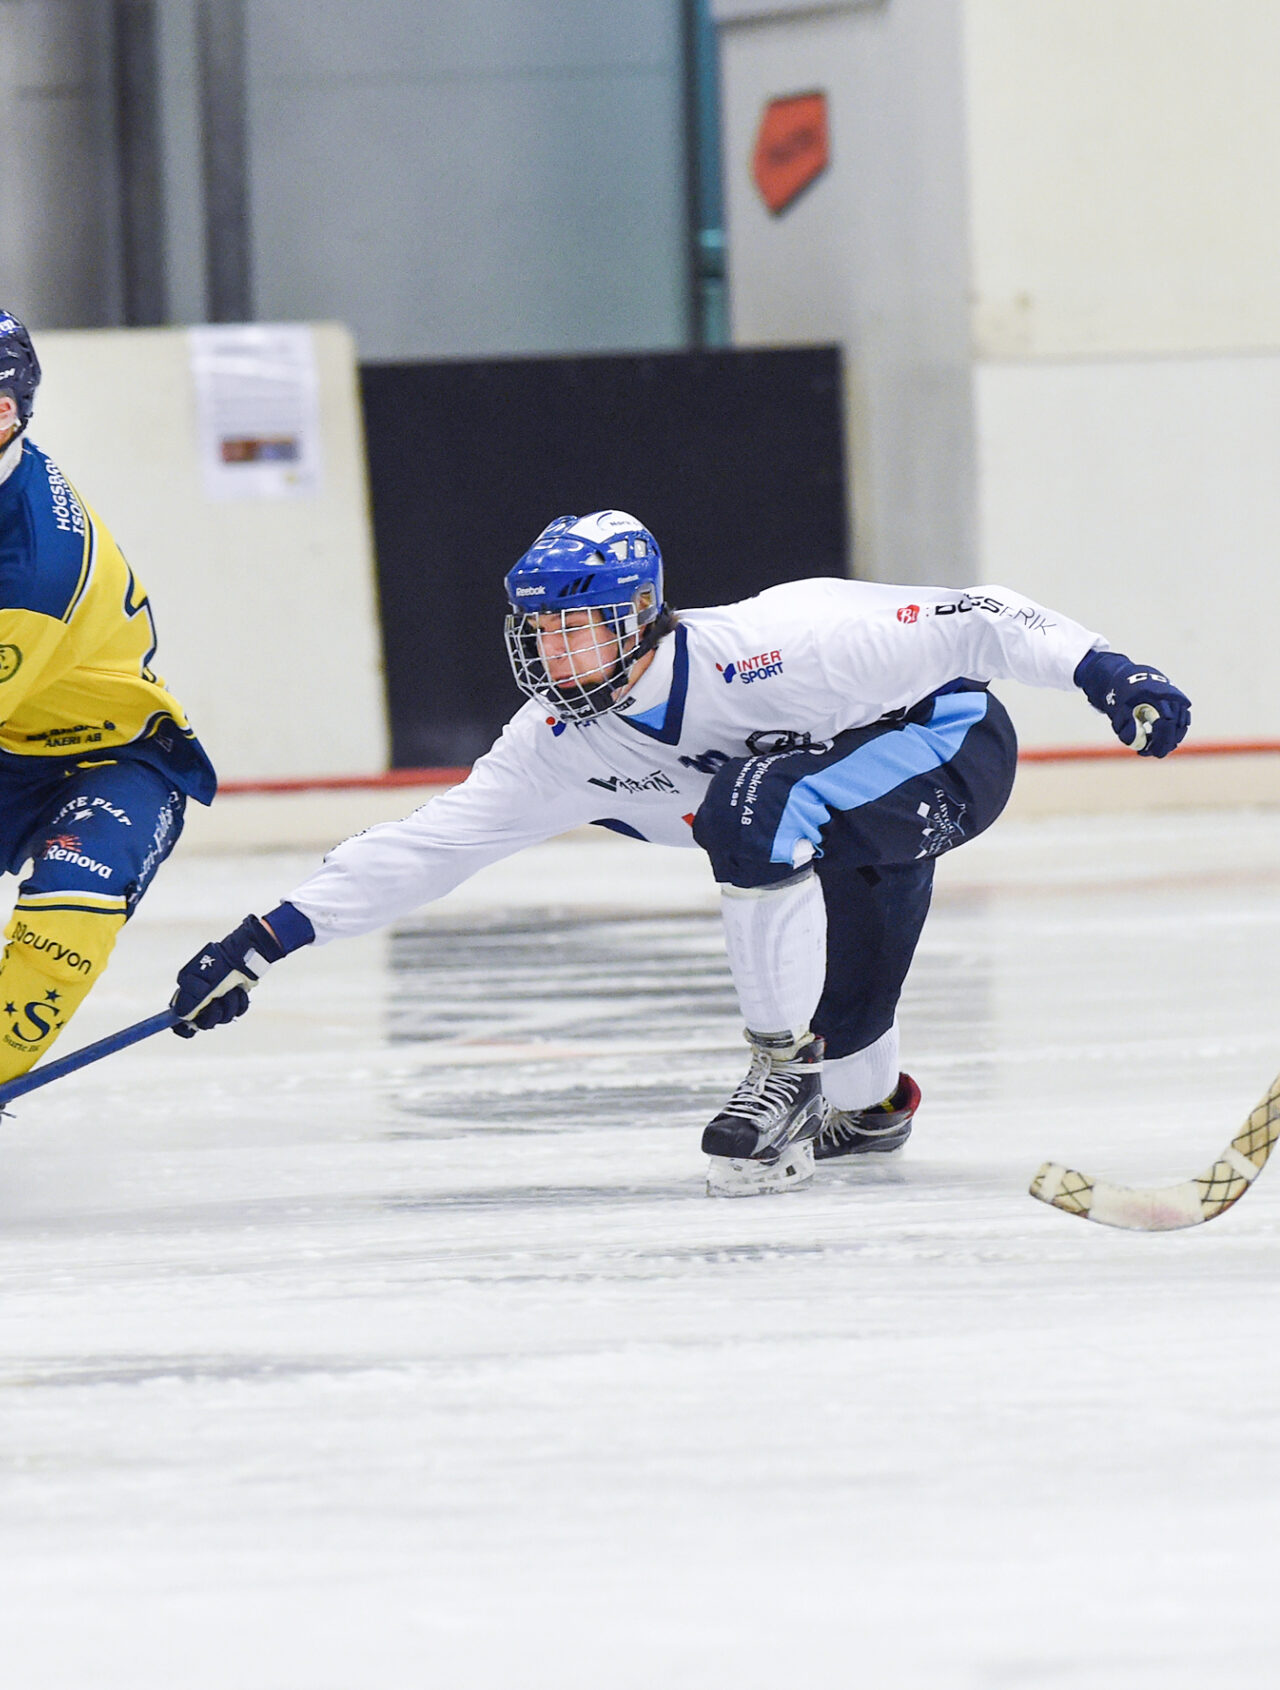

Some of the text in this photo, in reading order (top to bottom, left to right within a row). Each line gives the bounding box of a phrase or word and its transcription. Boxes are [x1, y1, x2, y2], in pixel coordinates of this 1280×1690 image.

[515, 585, 547, 597] Reebok
[736, 649, 782, 673] INTER
[739, 661, 784, 685] SPORT
[740, 805, 755, 826] AB
[43, 844, 113, 880] Renova
[12, 921, 93, 976] Nouryon
[11, 1001, 61, 1043] S
